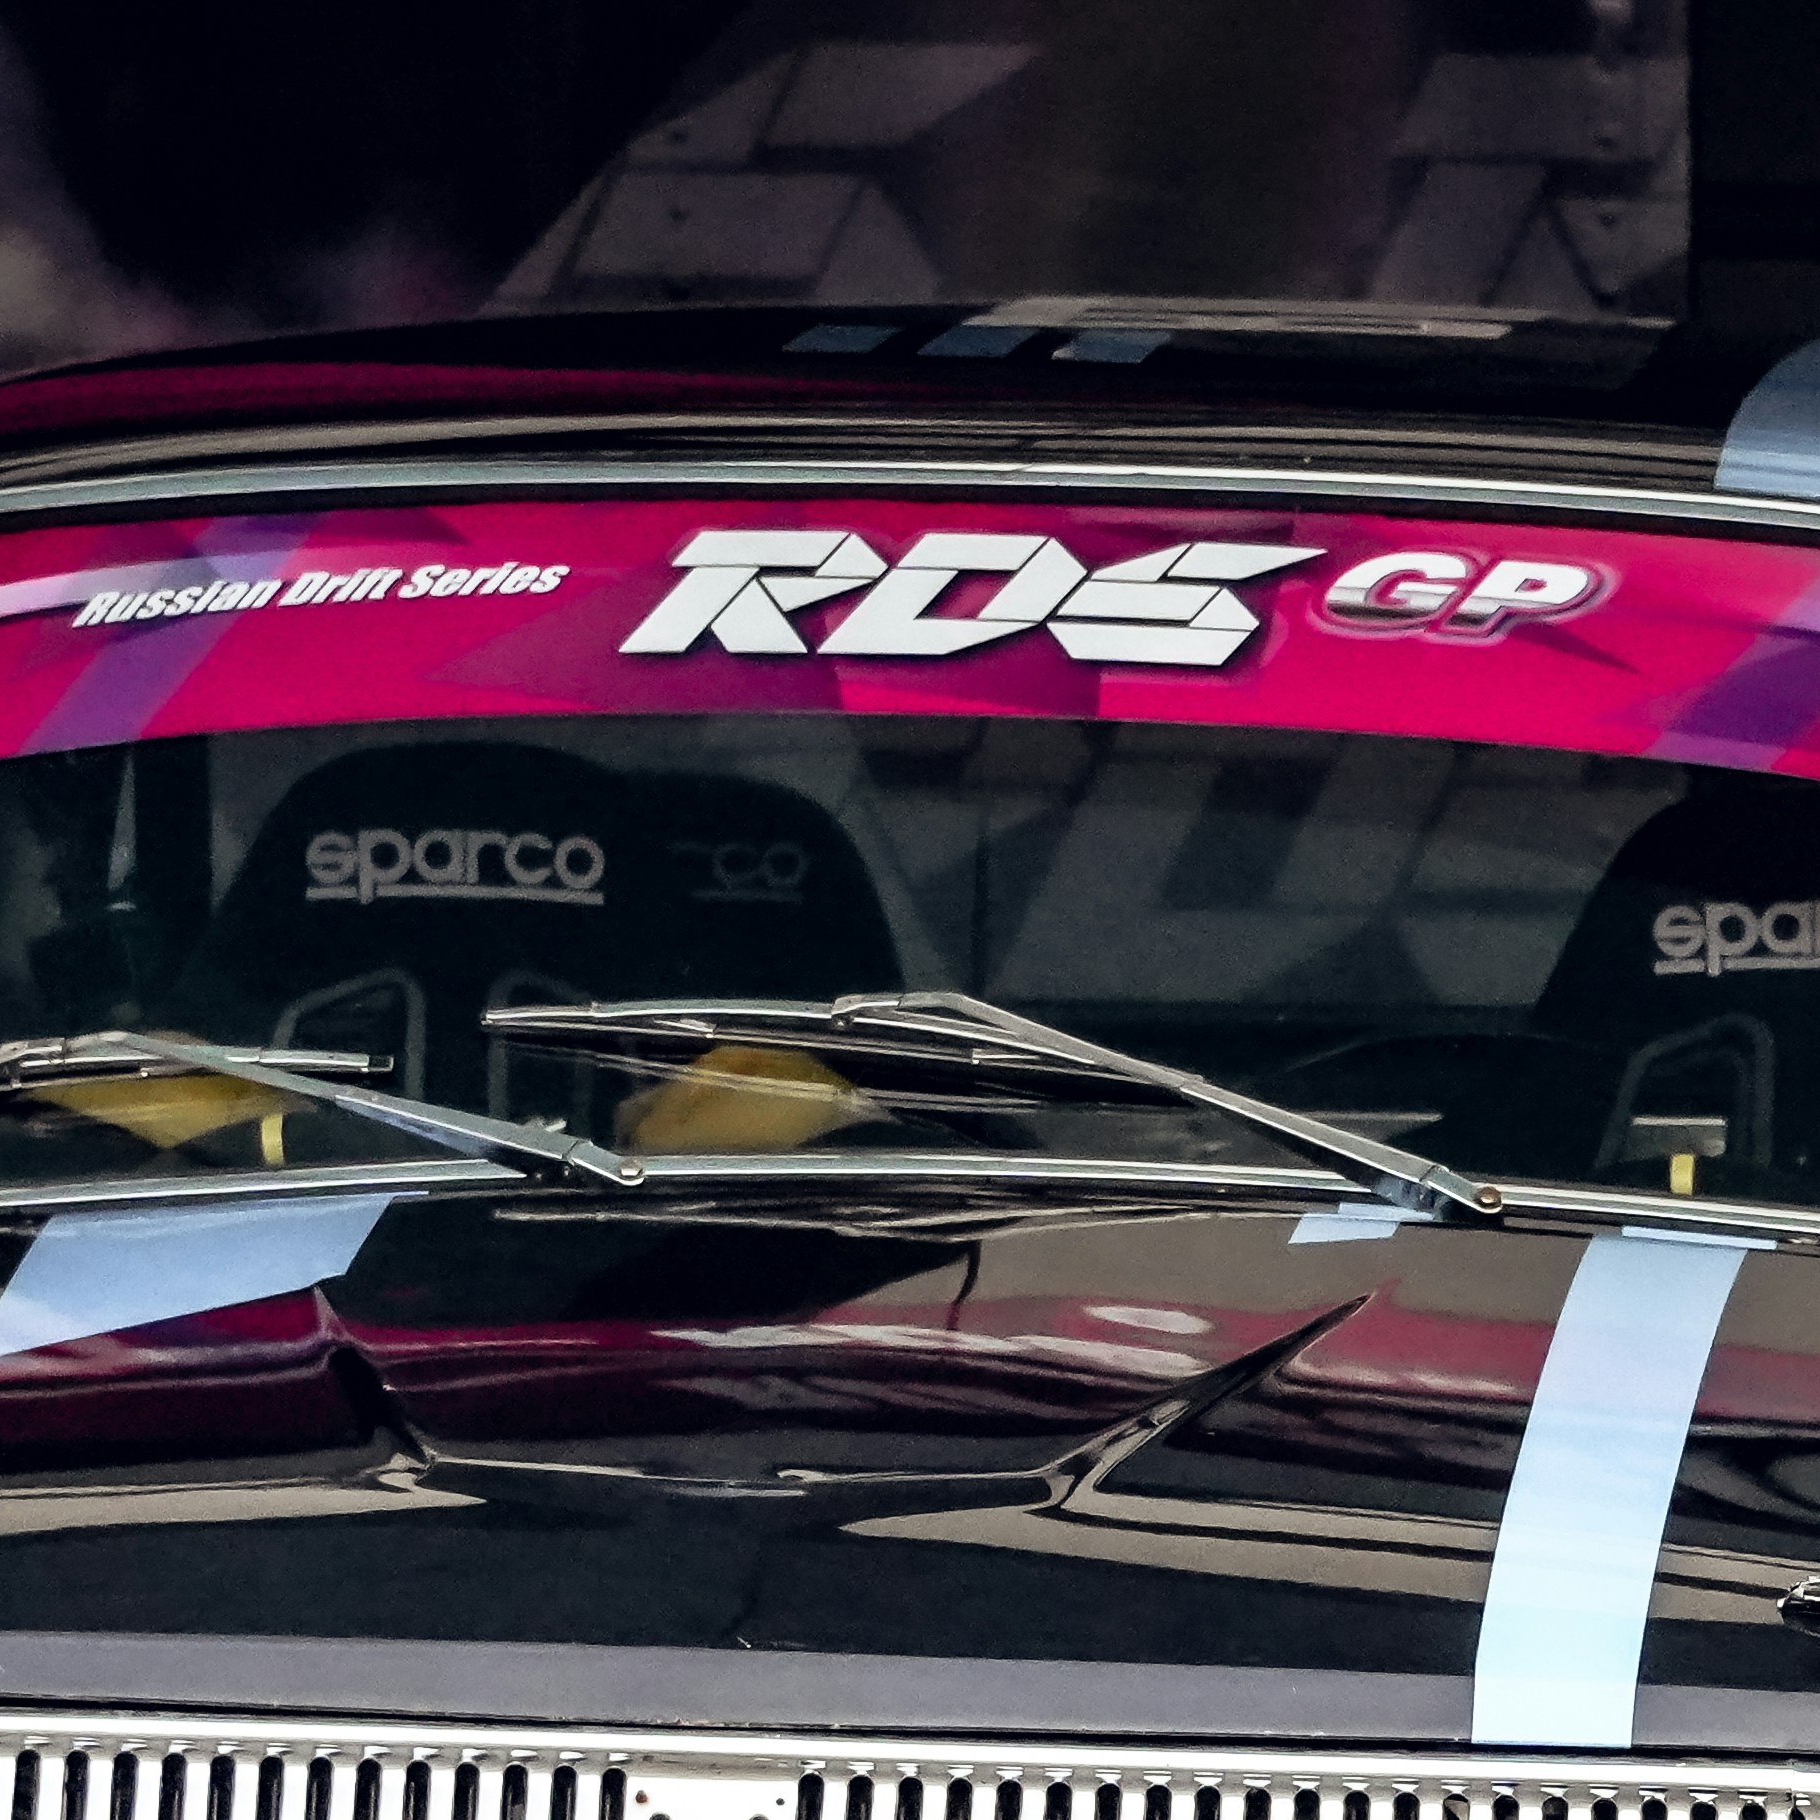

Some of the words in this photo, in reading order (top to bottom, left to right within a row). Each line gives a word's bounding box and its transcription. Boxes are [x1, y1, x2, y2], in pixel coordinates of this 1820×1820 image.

[71, 578, 284, 628] Russian
[277, 566, 406, 608] Drift
[397, 561, 572, 599] Series
[617, 529, 1329, 667] RDS
[1321, 549, 1595, 637] GP
[305, 828, 606, 904] sparco
